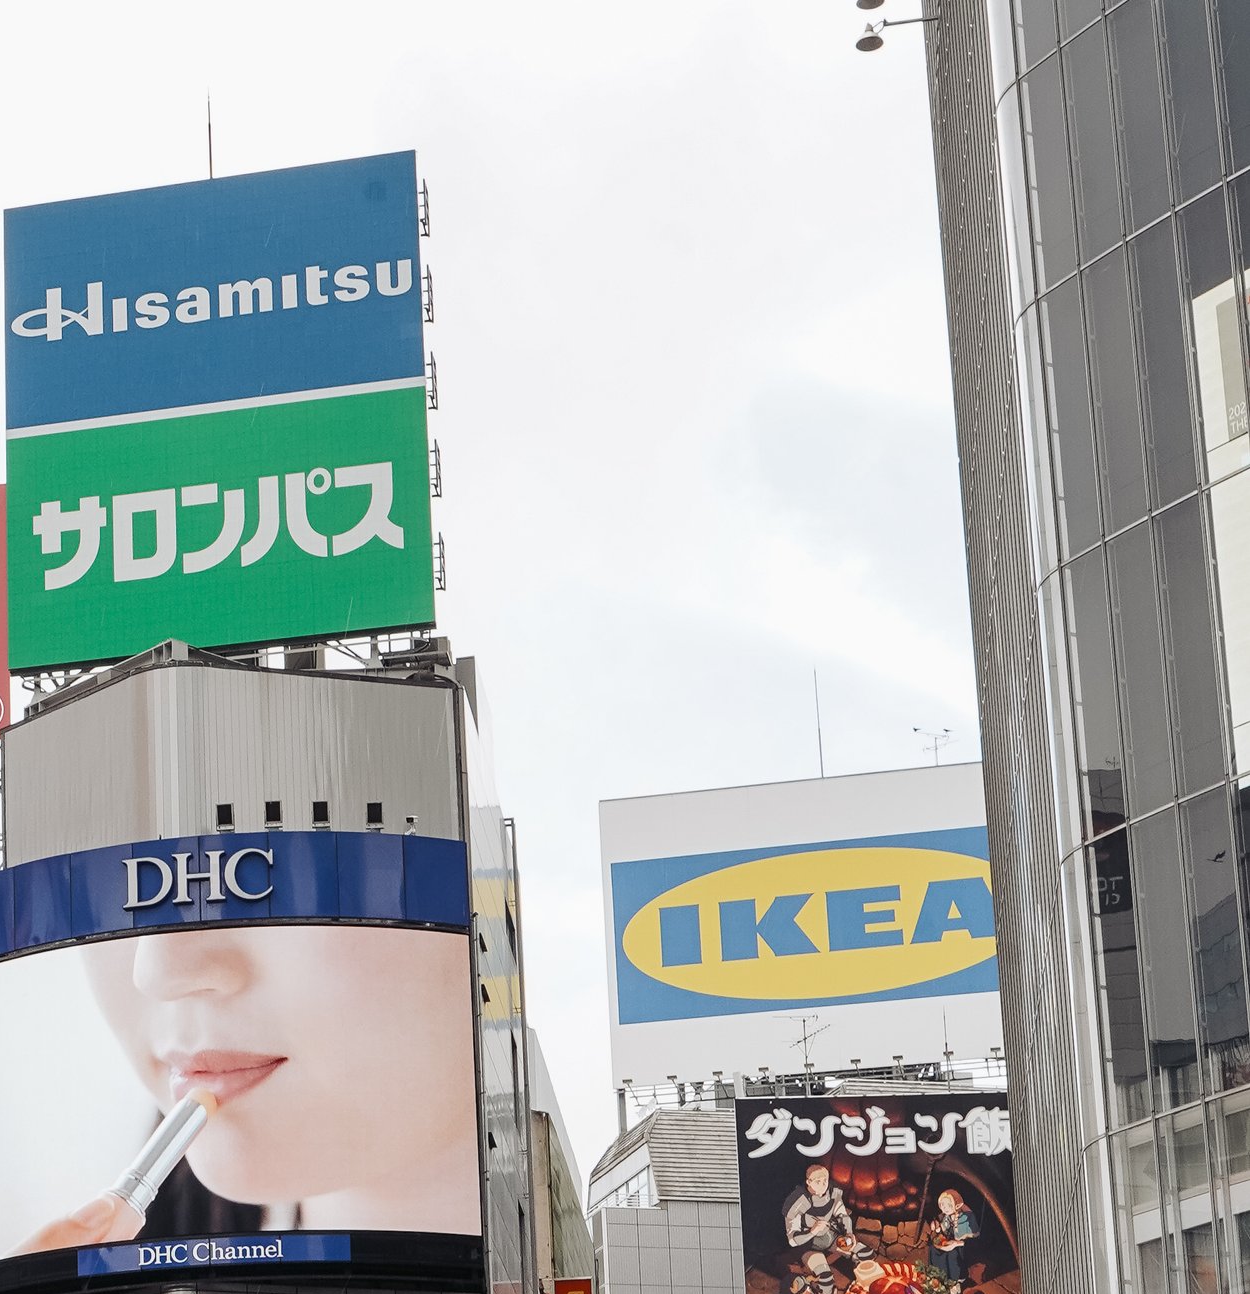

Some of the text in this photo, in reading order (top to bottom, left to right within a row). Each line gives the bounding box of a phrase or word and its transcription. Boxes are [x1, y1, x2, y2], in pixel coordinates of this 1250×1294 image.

[10, 258, 413, 342] Hisamitsu
[33, 461, 404, 591] サロンパス
[122, 848, 274, 911] DHC
[659, 876, 996, 967] IKEA
[745, 1105, 1013, 1158] ダンジョン飯
[138, 1239, 284, 1266] DHC Channel
